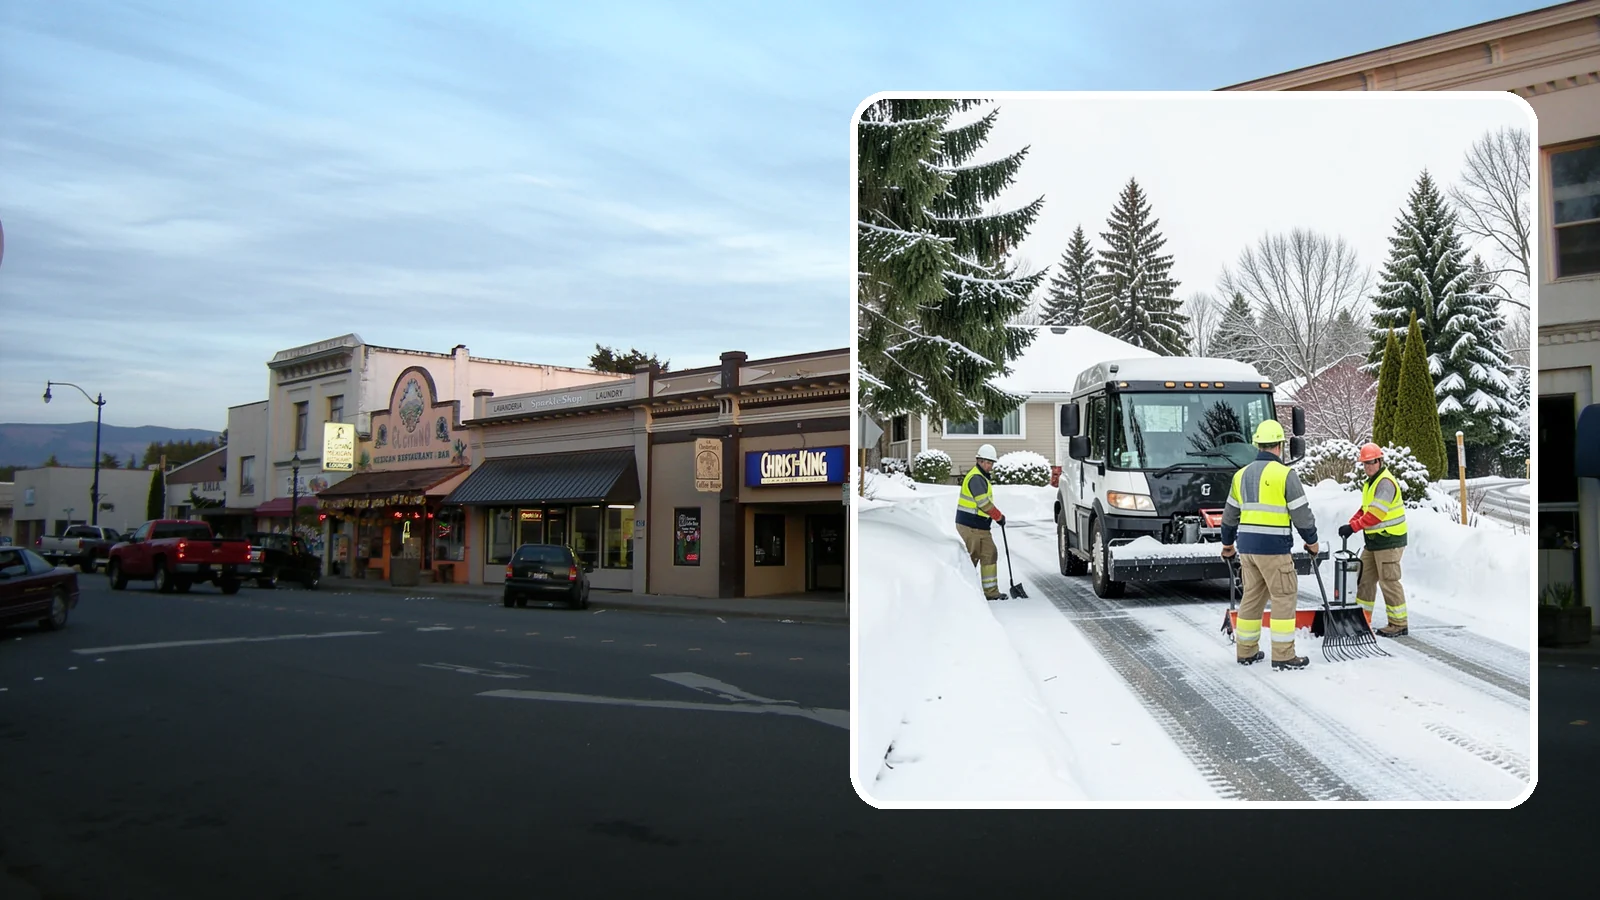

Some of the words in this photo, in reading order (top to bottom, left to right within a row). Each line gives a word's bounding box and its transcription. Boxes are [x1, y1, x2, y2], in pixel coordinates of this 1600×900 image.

[561, 394, 583, 405] Shop
[595, 388, 623, 400] LAUNDRY
[493, 402, 523, 412] LAVANDERIA
[373, 454, 397, 464] MEXICAN
[397, 451, 433, 463] RESTAURANT
[437, 449, 450, 459] BAR
[761, 452, 797, 478] CHRIST
[799, 450, 827, 477] KING
